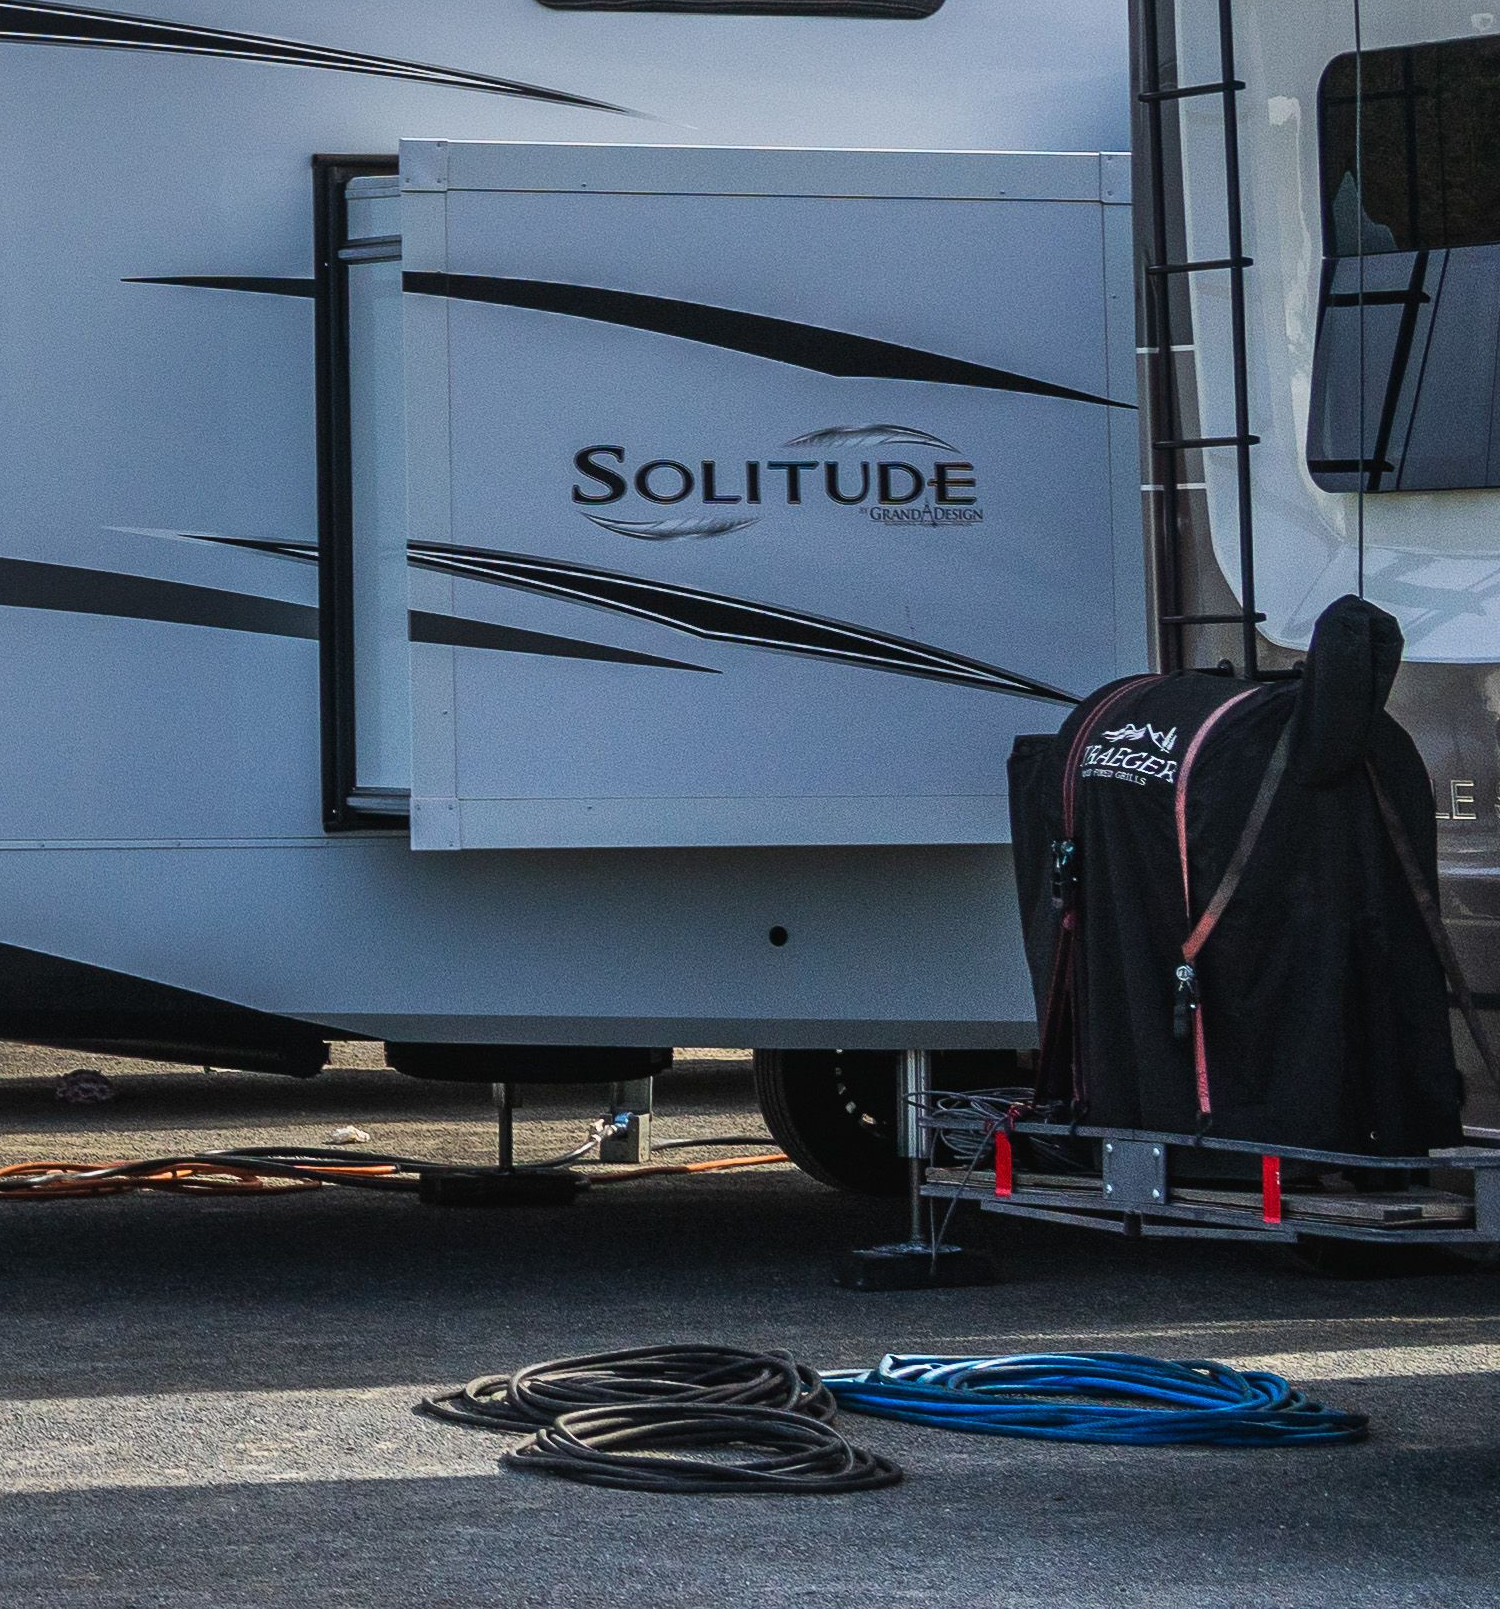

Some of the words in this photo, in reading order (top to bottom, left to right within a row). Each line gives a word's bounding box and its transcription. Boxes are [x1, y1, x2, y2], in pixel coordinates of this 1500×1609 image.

[571, 443, 978, 506] SOLITUDE
[869, 507, 922, 521] GRAND
[934, 506, 984, 521] DESIGN
[1114, 771, 1147, 786] GRILLS
